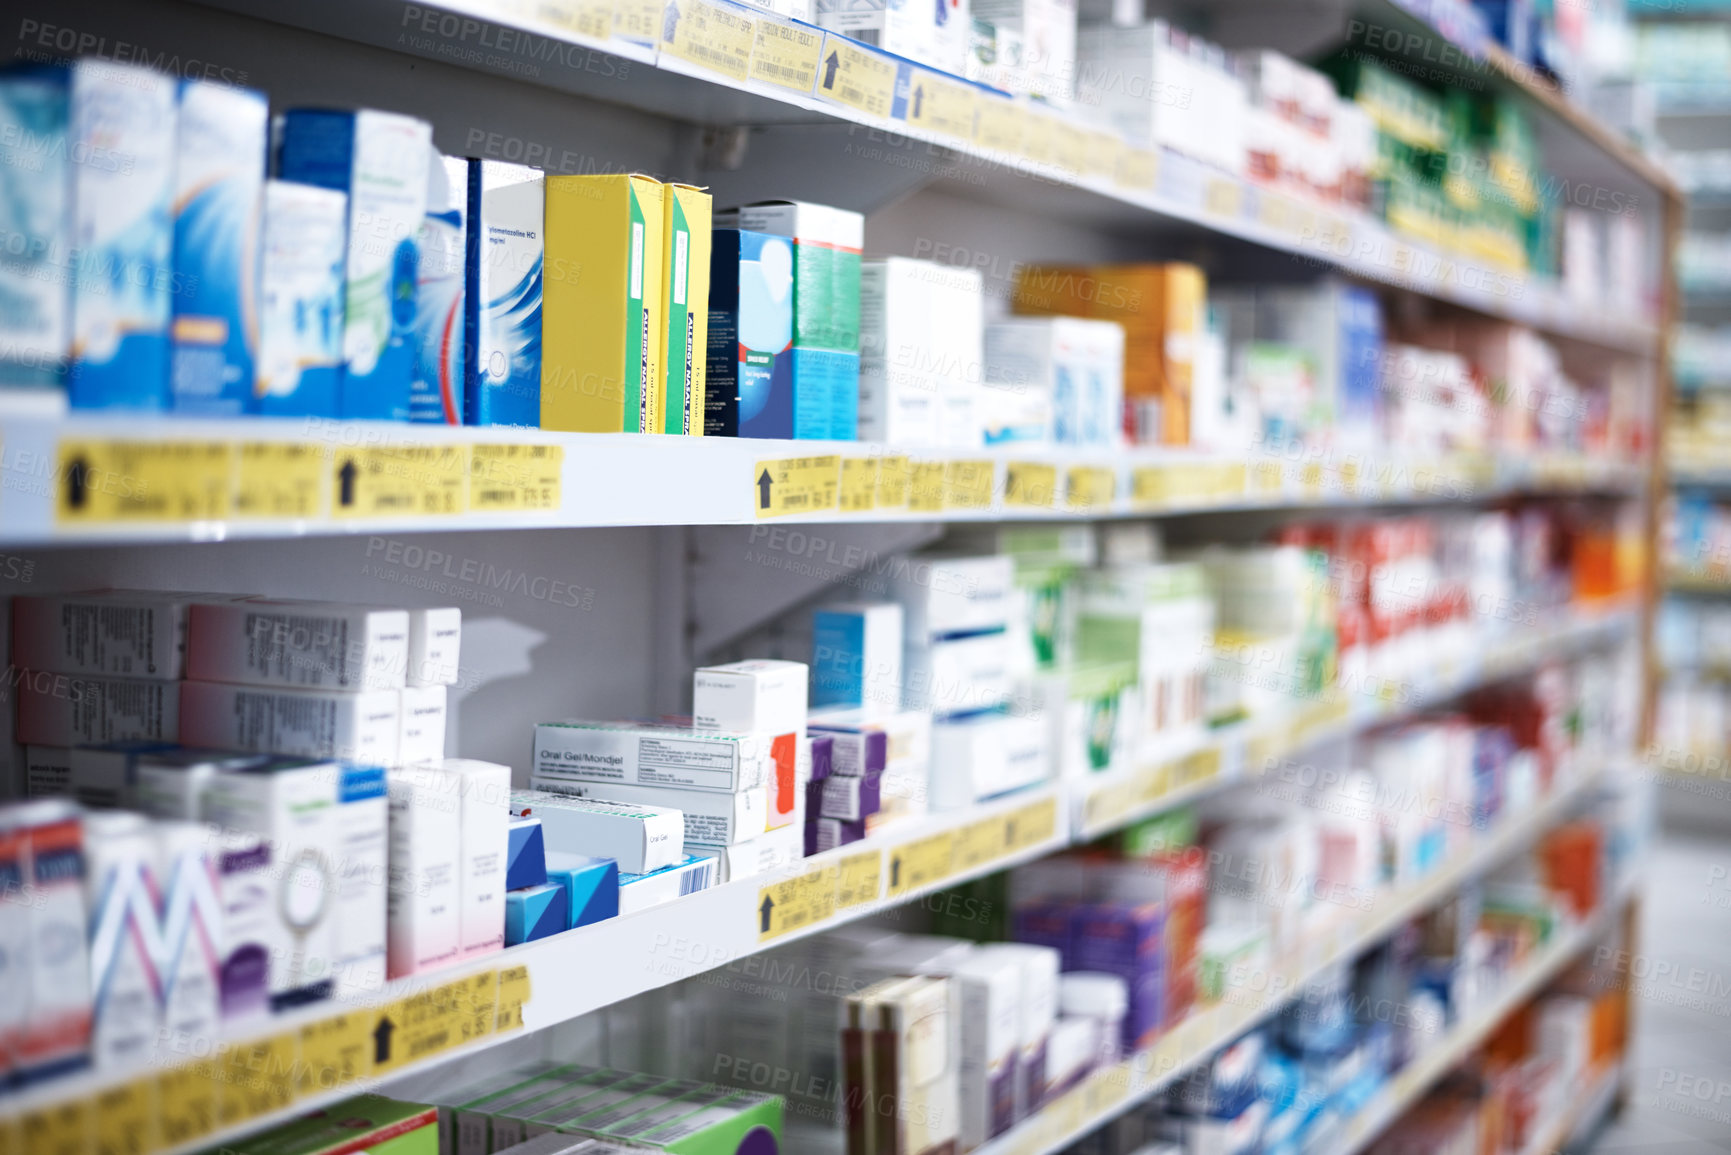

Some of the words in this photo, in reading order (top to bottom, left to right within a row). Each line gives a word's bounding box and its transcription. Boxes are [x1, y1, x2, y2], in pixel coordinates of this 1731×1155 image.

[488, 226, 526, 238] ylometazoline
[540, 750, 562, 760] Oral
[564, 751, 624, 766] Gel/Mondjel
